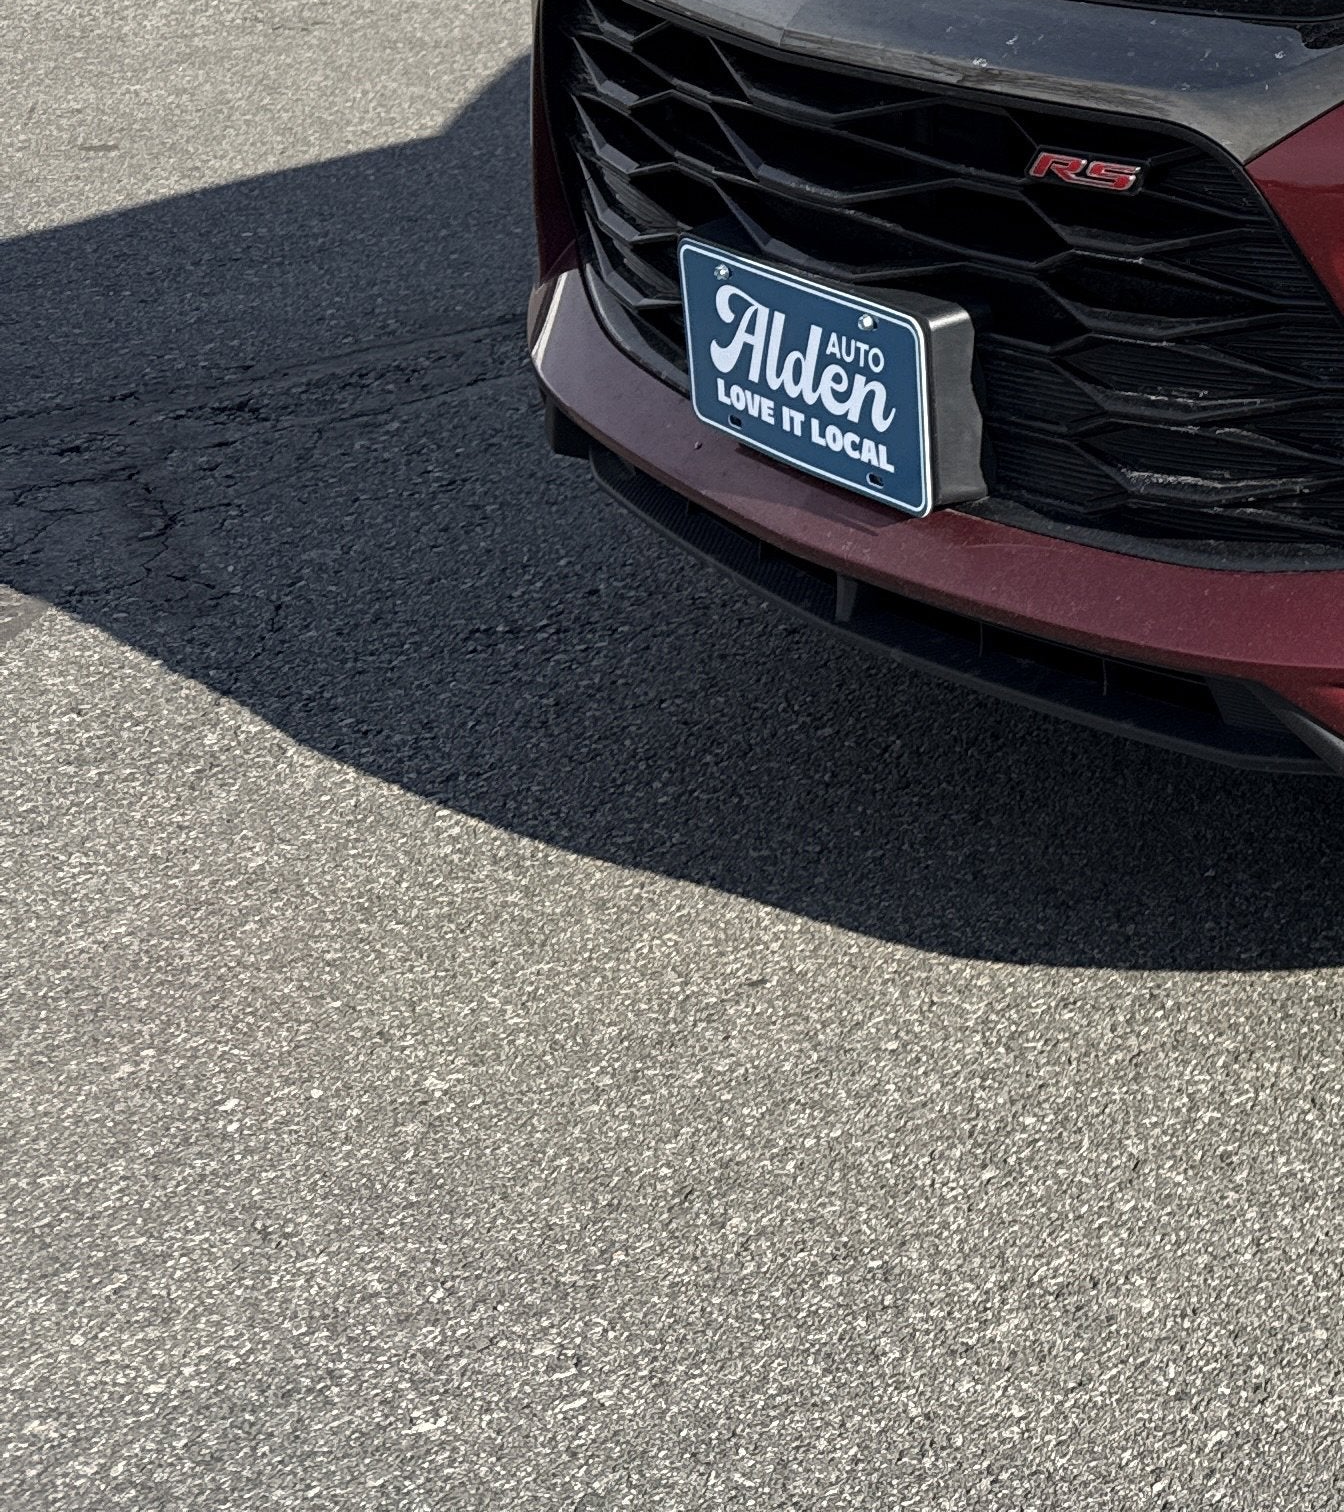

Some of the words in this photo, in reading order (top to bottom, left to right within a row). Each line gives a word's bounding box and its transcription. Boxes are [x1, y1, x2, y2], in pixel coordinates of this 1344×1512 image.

[1028, 151, 1142, 191] RS
[709, 284, 896, 433] Alden
[825, 332, 885, 374] AUTO
[716, 378, 776, 425] LOVE
[782, 406, 806, 438] IT
[811, 417, 896, 474] LOCAL
